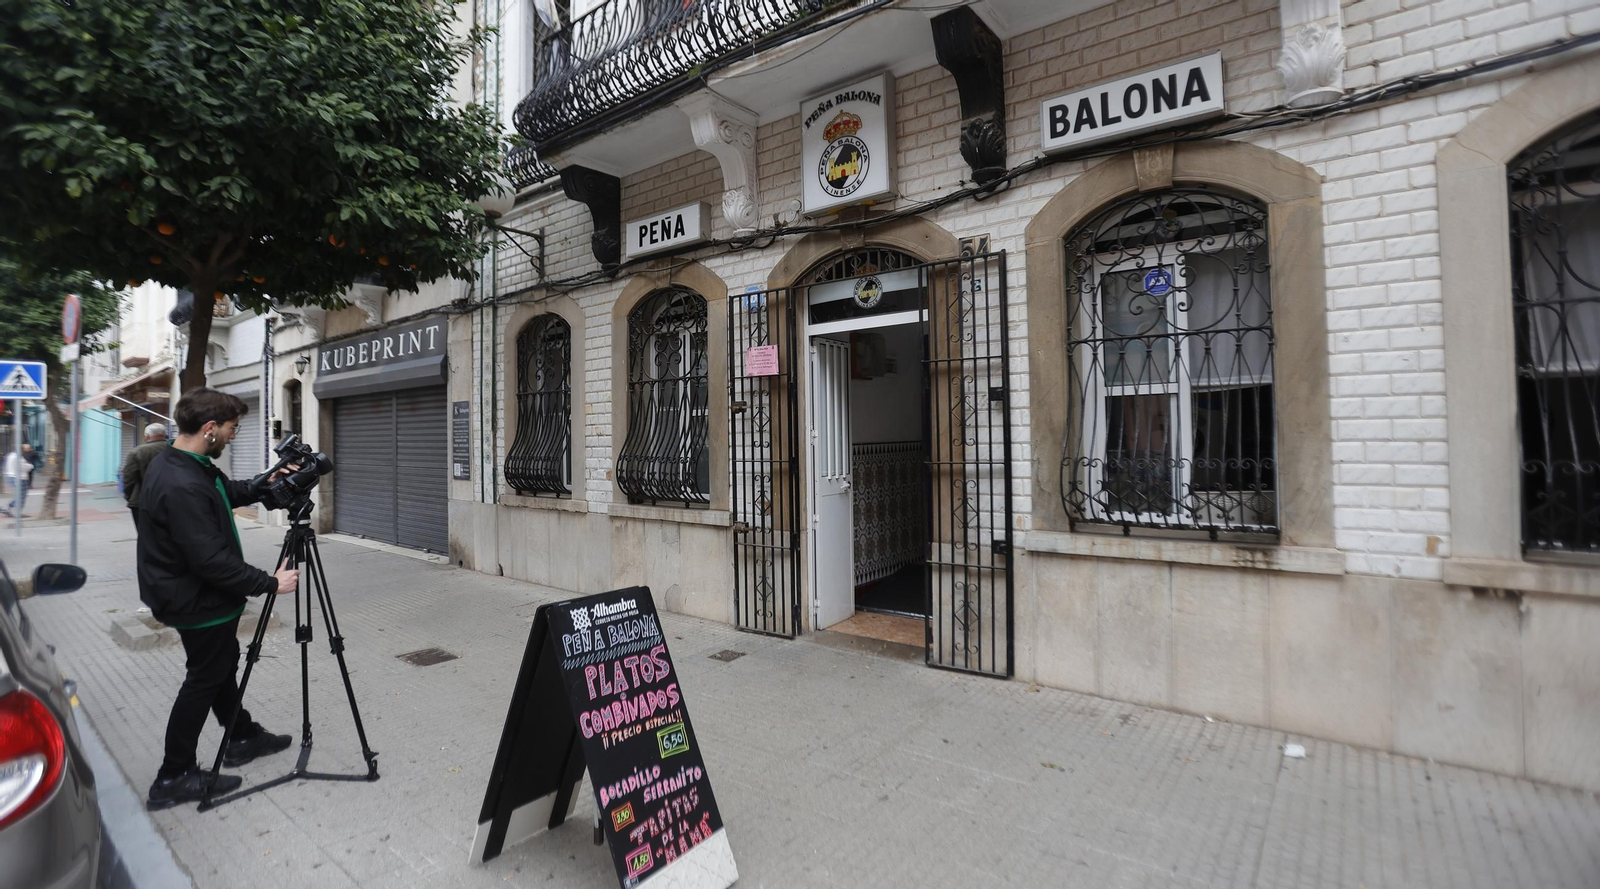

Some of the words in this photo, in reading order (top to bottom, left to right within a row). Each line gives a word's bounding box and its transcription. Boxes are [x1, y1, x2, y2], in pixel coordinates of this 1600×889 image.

[804, 99, 834, 130] PEÑA
[835, 90, 882, 107] BALONA
[1049, 66, 1211, 139] BALONA
[837, 138, 868, 163] BALONA
[825, 179, 862, 195] LINENSE
[639, 213, 685, 248] PEÑA
[320, 325, 439, 371] KUBEPRINT
[591, 598, 637, 620] Alhambra
[562, 627, 606, 657] PEÑA
[607, 613, 660, 648] BALONA
[584, 643, 670, 700] PLATOS
[579, 682, 680, 739] COMBINADOS
[663, 732, 683, 750] 6,50
[600, 765, 660, 810] BOCADILLO
[643, 765, 702, 805] SERRANITO
[662, 827, 675, 847] DE
[679, 818, 690, 835] LA
